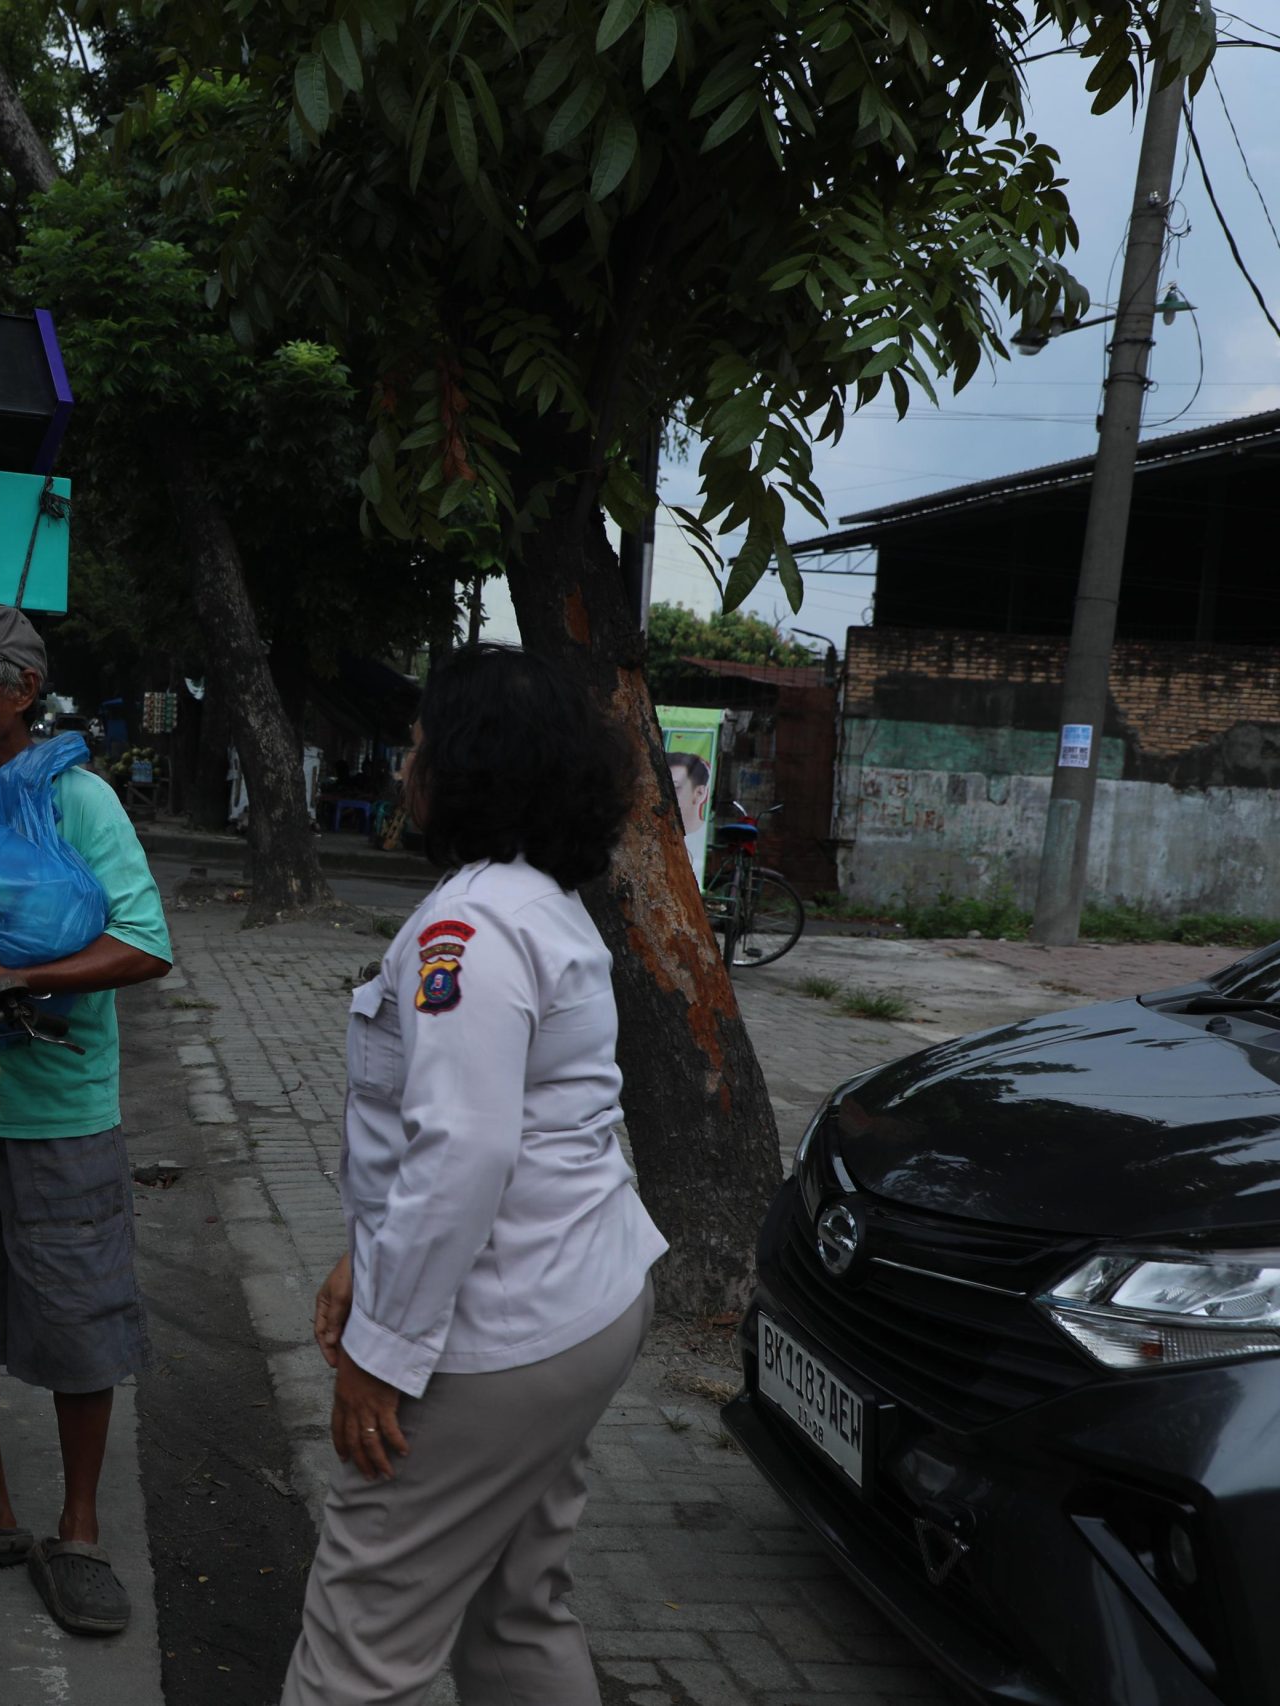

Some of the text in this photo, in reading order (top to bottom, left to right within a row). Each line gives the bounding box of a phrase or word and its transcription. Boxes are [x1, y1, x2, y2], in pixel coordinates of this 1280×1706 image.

[764, 1323, 863, 1453] BK 1183 AEW
